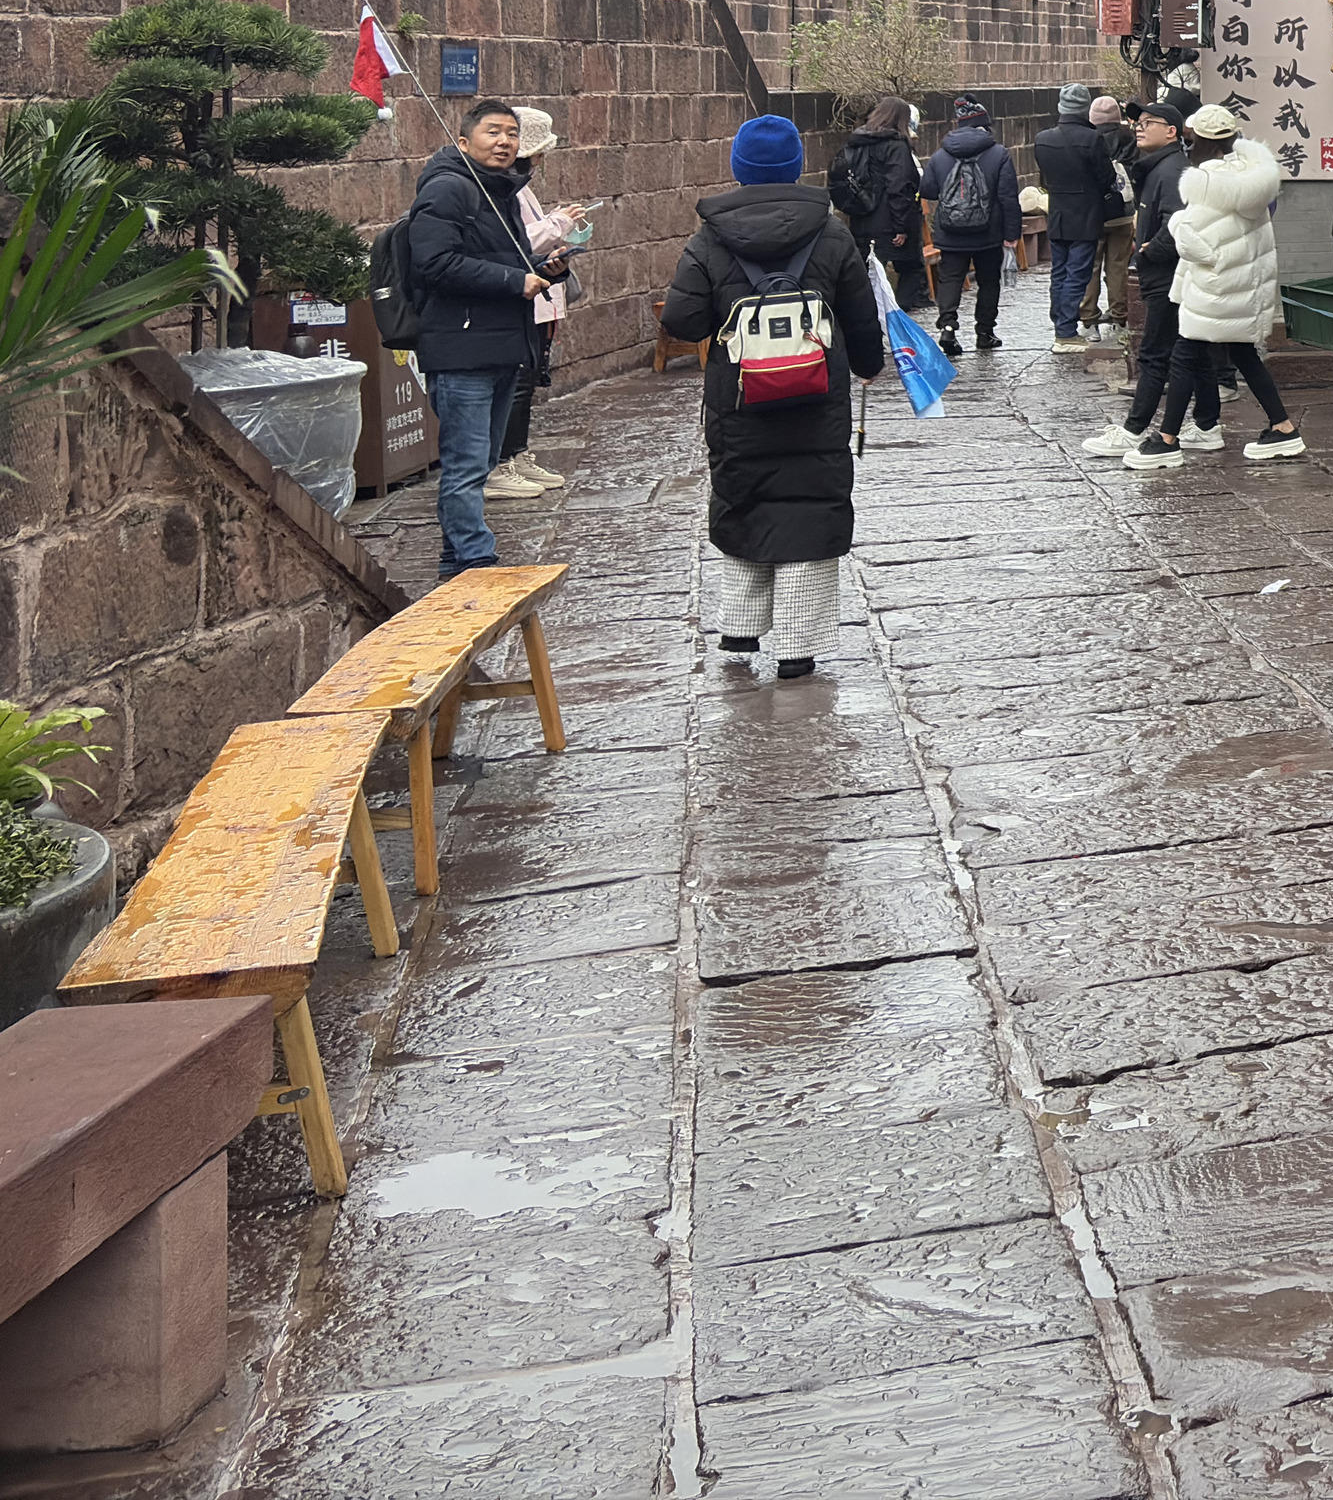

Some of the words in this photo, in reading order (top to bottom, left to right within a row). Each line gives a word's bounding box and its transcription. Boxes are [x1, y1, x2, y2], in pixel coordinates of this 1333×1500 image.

[1272, 16, 1317, 178] 所以我等
[394, 381, 413, 405] 119
